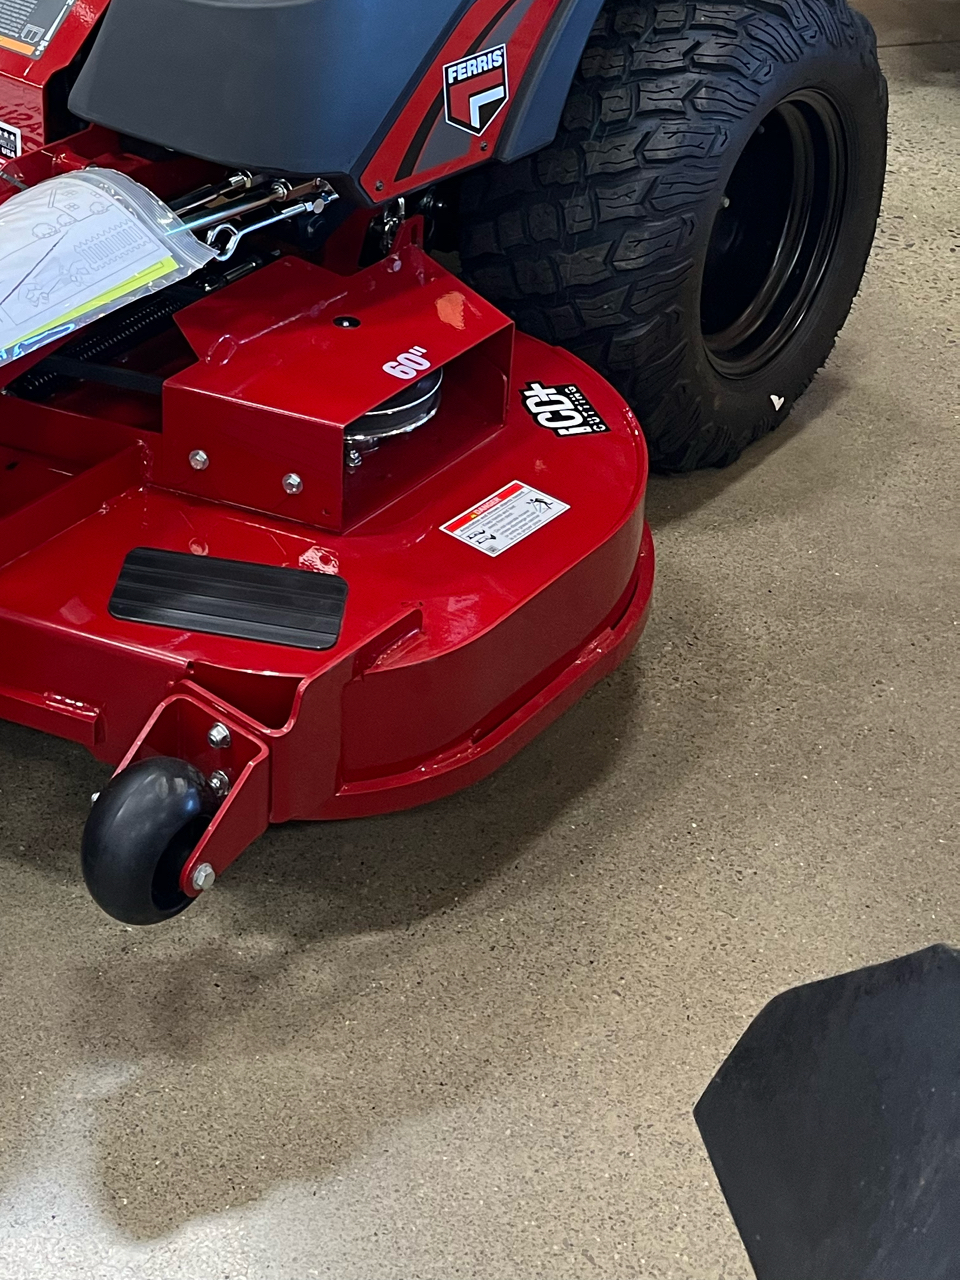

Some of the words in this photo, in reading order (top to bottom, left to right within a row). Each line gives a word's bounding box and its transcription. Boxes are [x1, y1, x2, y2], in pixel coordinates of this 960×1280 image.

[448, 49, 503, 84] FERRIS
[1, 146, 16, 158] USA
[382, 346, 431, 380] 60"
[564, 386, 607, 432] CUTTING
[473, 496, 502, 514] DANGER
